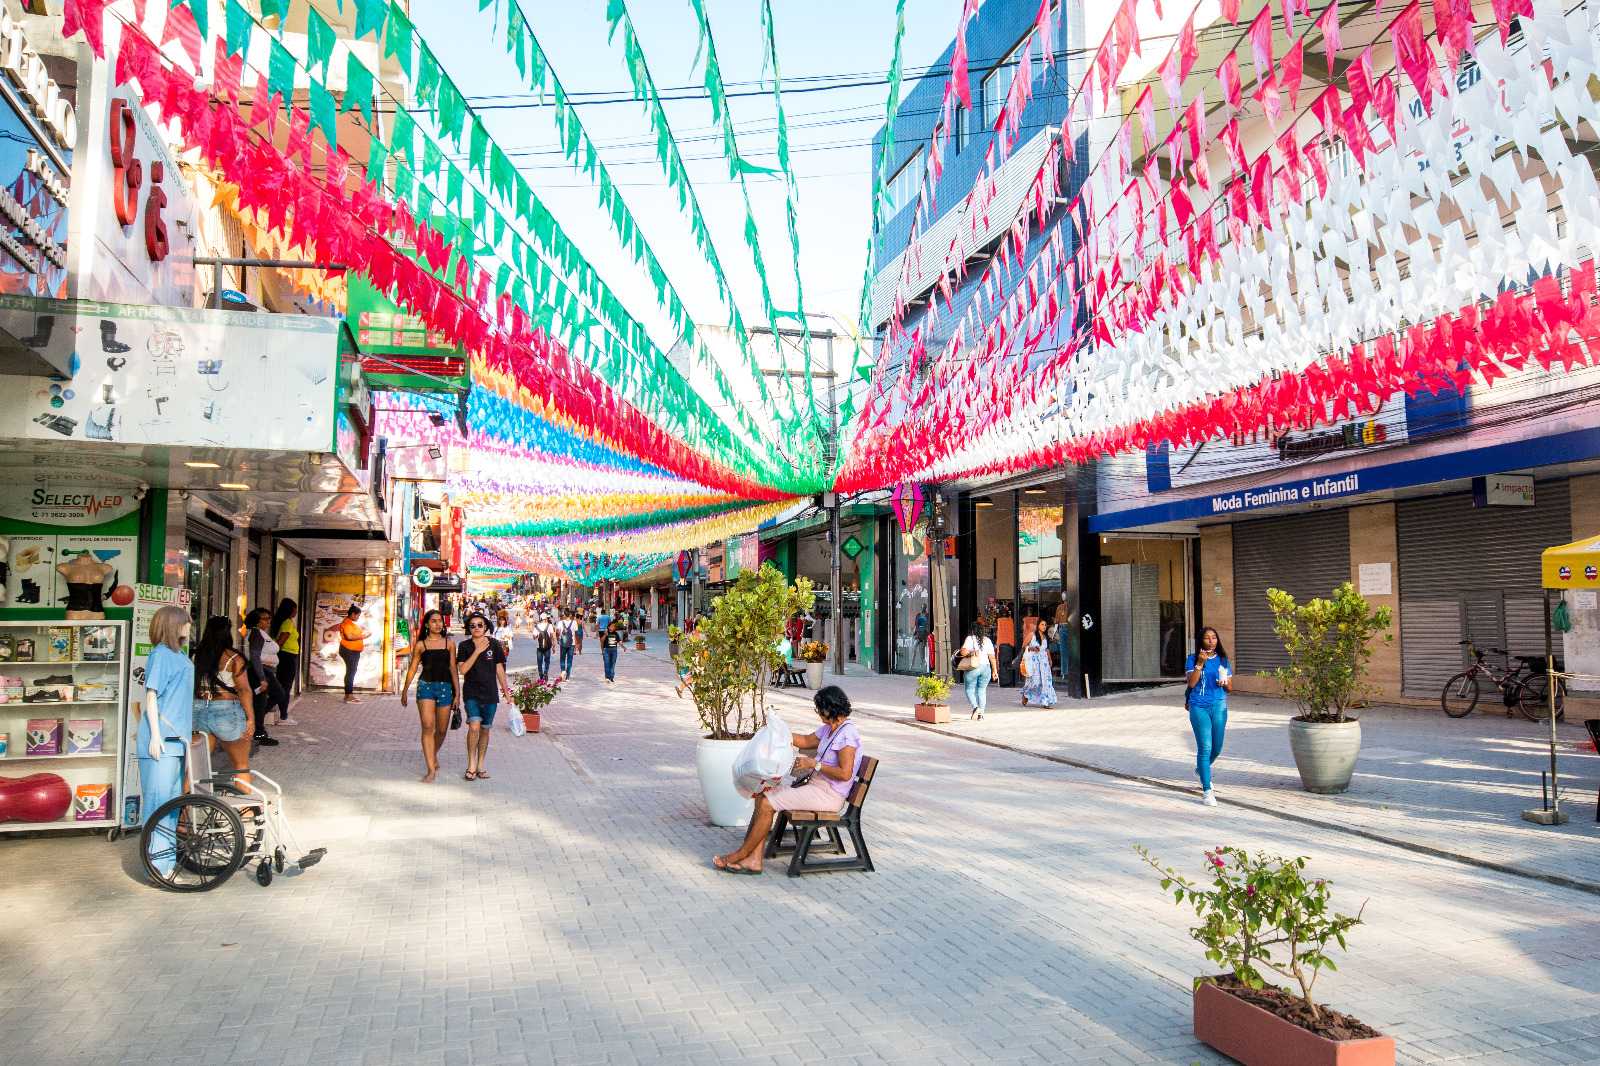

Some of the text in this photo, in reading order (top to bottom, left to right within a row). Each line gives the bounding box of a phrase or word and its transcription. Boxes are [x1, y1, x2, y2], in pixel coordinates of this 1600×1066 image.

[118, 307, 176, 320] ARTIGOS
[222, 313, 265, 326] SAÚDE
[1212, 474, 1359, 512] Moda Feminina e Infantil
[1501, 483, 1534, 494] Impacto
